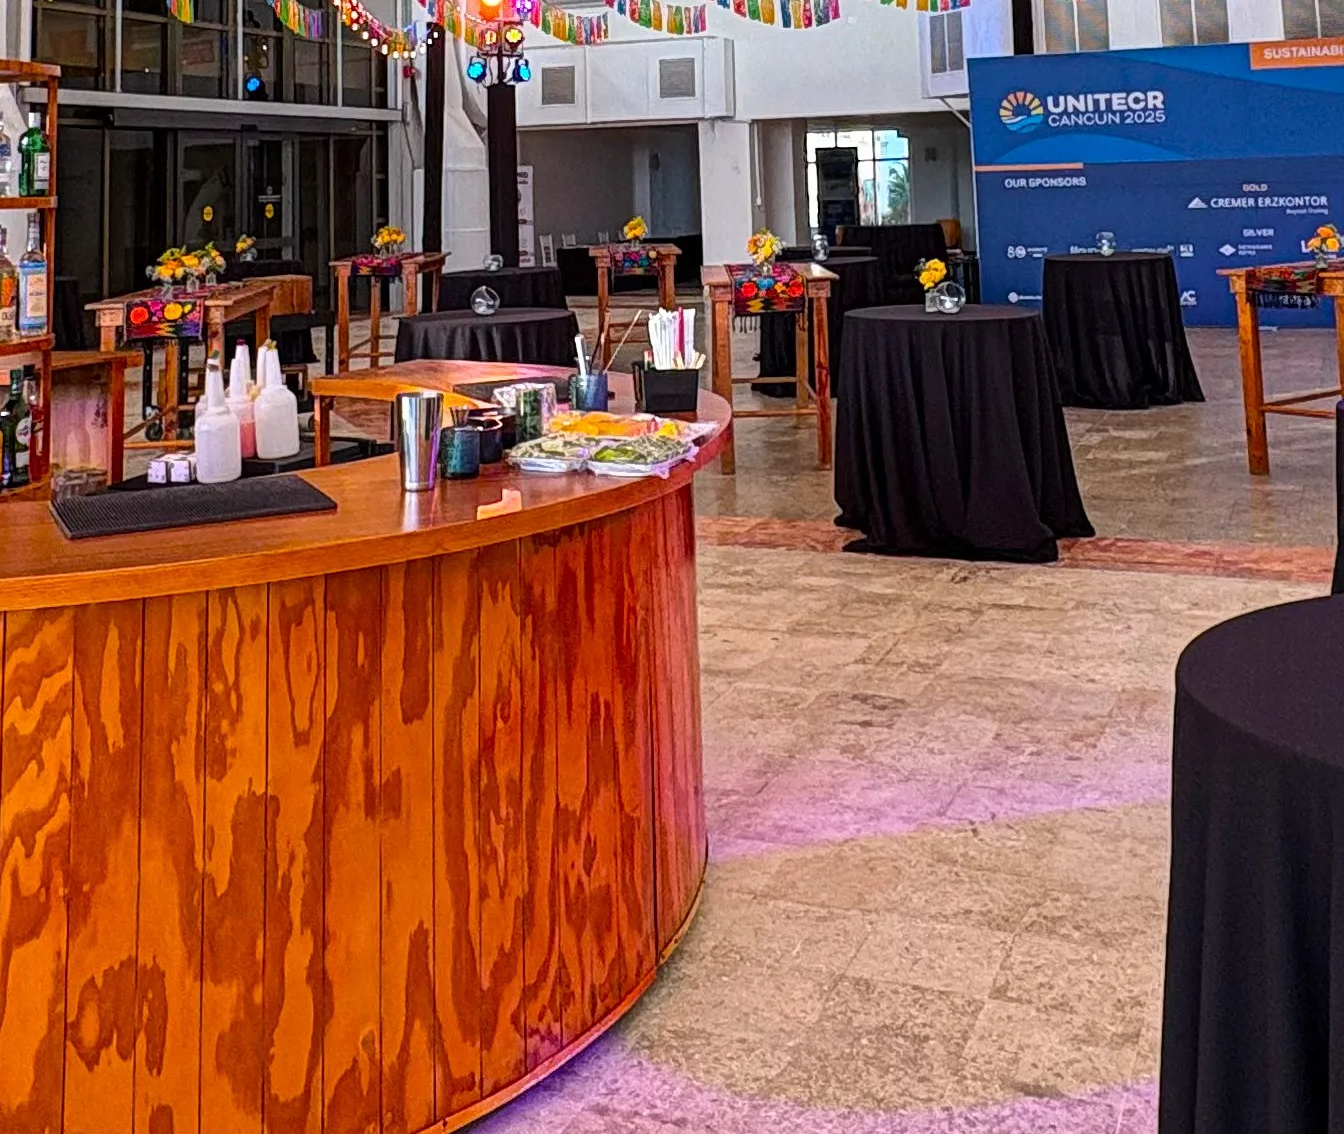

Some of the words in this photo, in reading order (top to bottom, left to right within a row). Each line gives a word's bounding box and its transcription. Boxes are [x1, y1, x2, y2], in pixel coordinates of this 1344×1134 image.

[1046, 91, 1165, 113] UNITECR
[1048, 112, 1121, 127] CANCUN
[1124, 110, 1166, 124] 2025
[1004, 178, 1027, 189] OUR
[1028, 176, 1087, 188] SPONSORS
[1242, 183, 1268, 192] GOLD
[1210, 197, 1255, 208] CREMER
[1258, 196, 1328, 207] ERZKONTOR
[1242, 228, 1275, 237] SILVER
